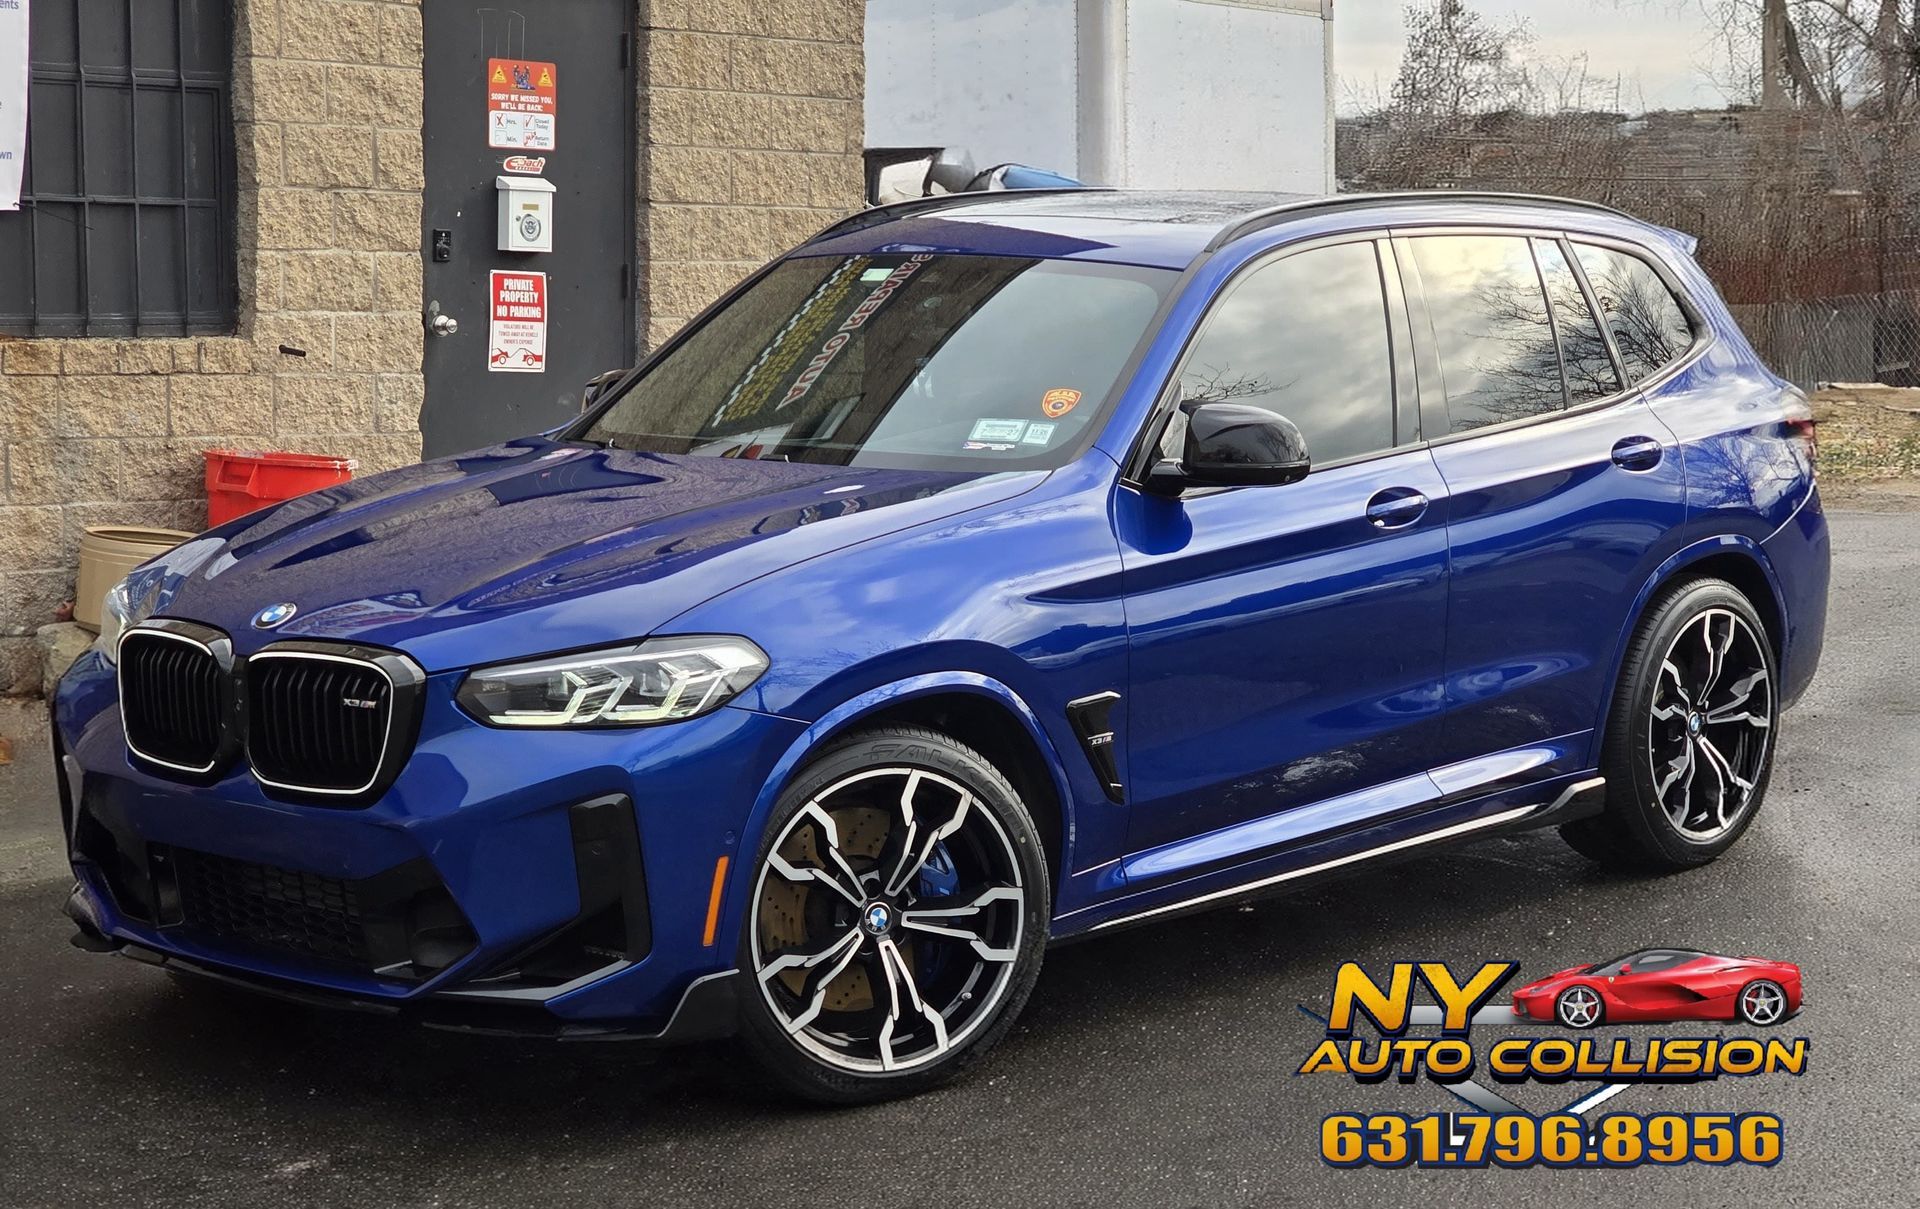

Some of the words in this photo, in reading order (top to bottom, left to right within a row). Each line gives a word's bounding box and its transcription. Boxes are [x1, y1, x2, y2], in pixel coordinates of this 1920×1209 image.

[503, 278, 534, 291] PRIVATE
[500, 290, 539, 303] PROPERTY
[497, 305, 508, 317] NO
[510, 305, 542, 318] PARKING
